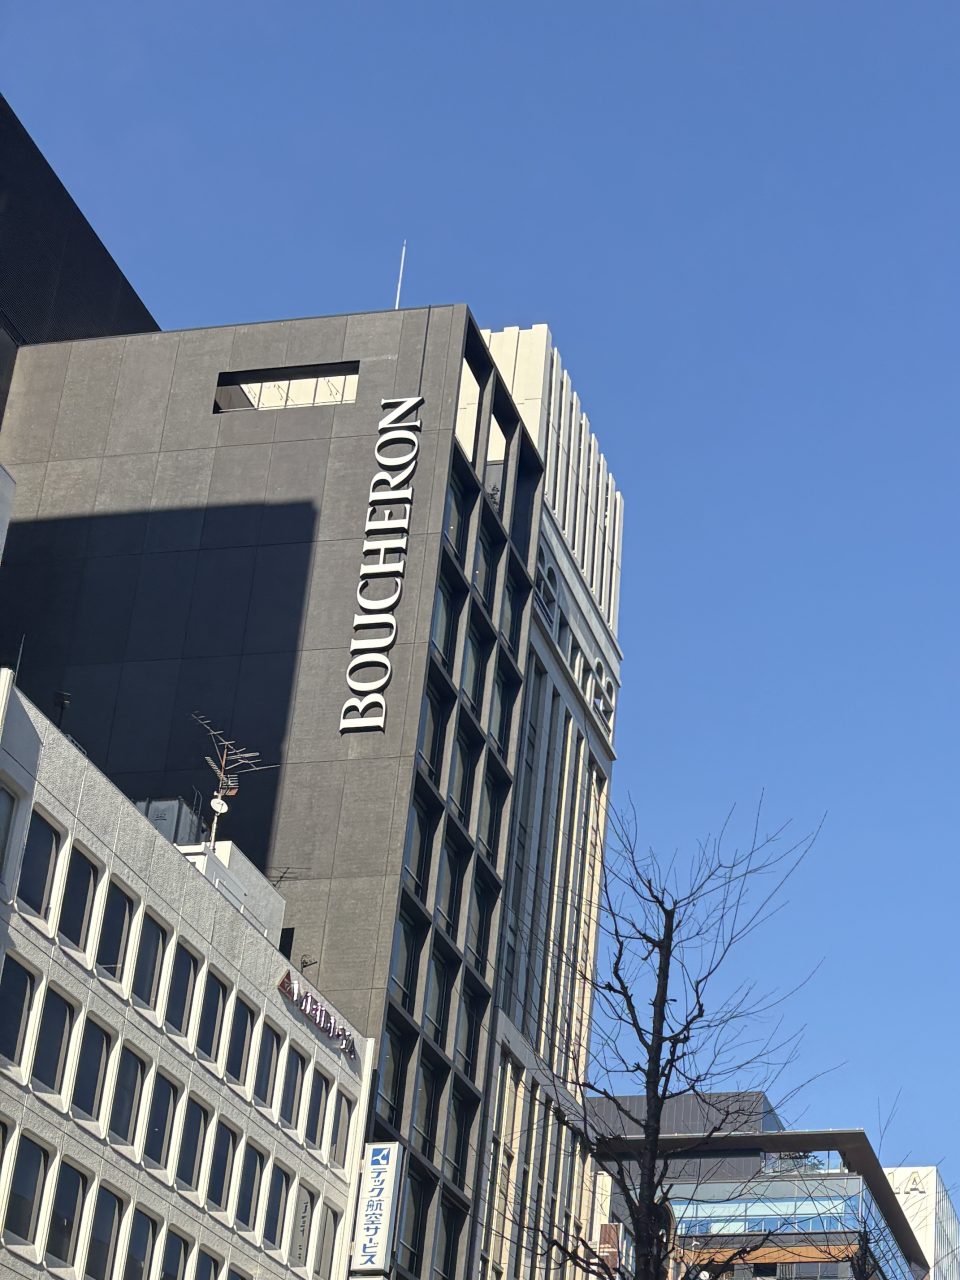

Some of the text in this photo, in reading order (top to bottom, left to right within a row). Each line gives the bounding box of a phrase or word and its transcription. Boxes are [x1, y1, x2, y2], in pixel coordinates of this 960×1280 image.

[339, 396, 424, 735] BOUCHERON
[360, 1168, 387, 1265] テック航空サービス
